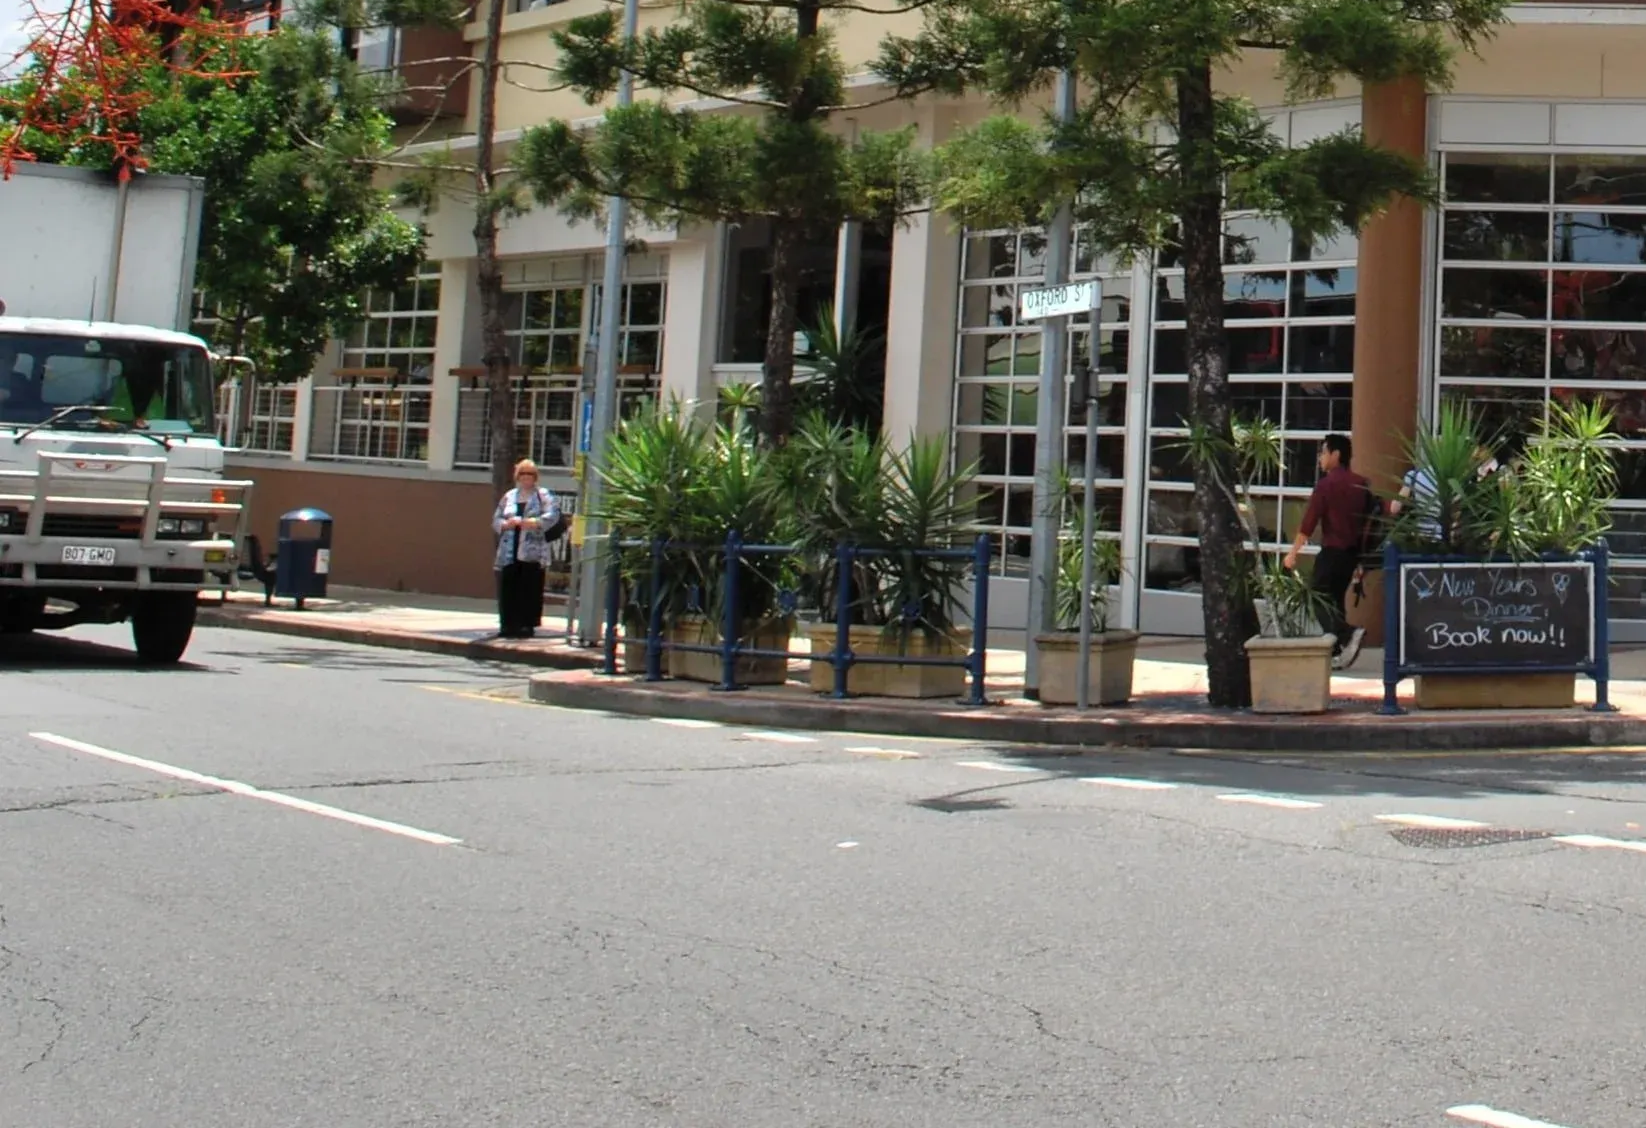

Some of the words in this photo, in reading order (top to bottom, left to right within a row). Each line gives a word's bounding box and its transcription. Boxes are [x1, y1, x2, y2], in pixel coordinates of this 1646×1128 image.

[1027, 286, 1068, 309] OXFORD
[1438, 572, 1476, 598] New
[1487, 571, 1538, 597] Years
[1425, 622, 1493, 650] Book
[1501, 623, 1566, 648] now!!
